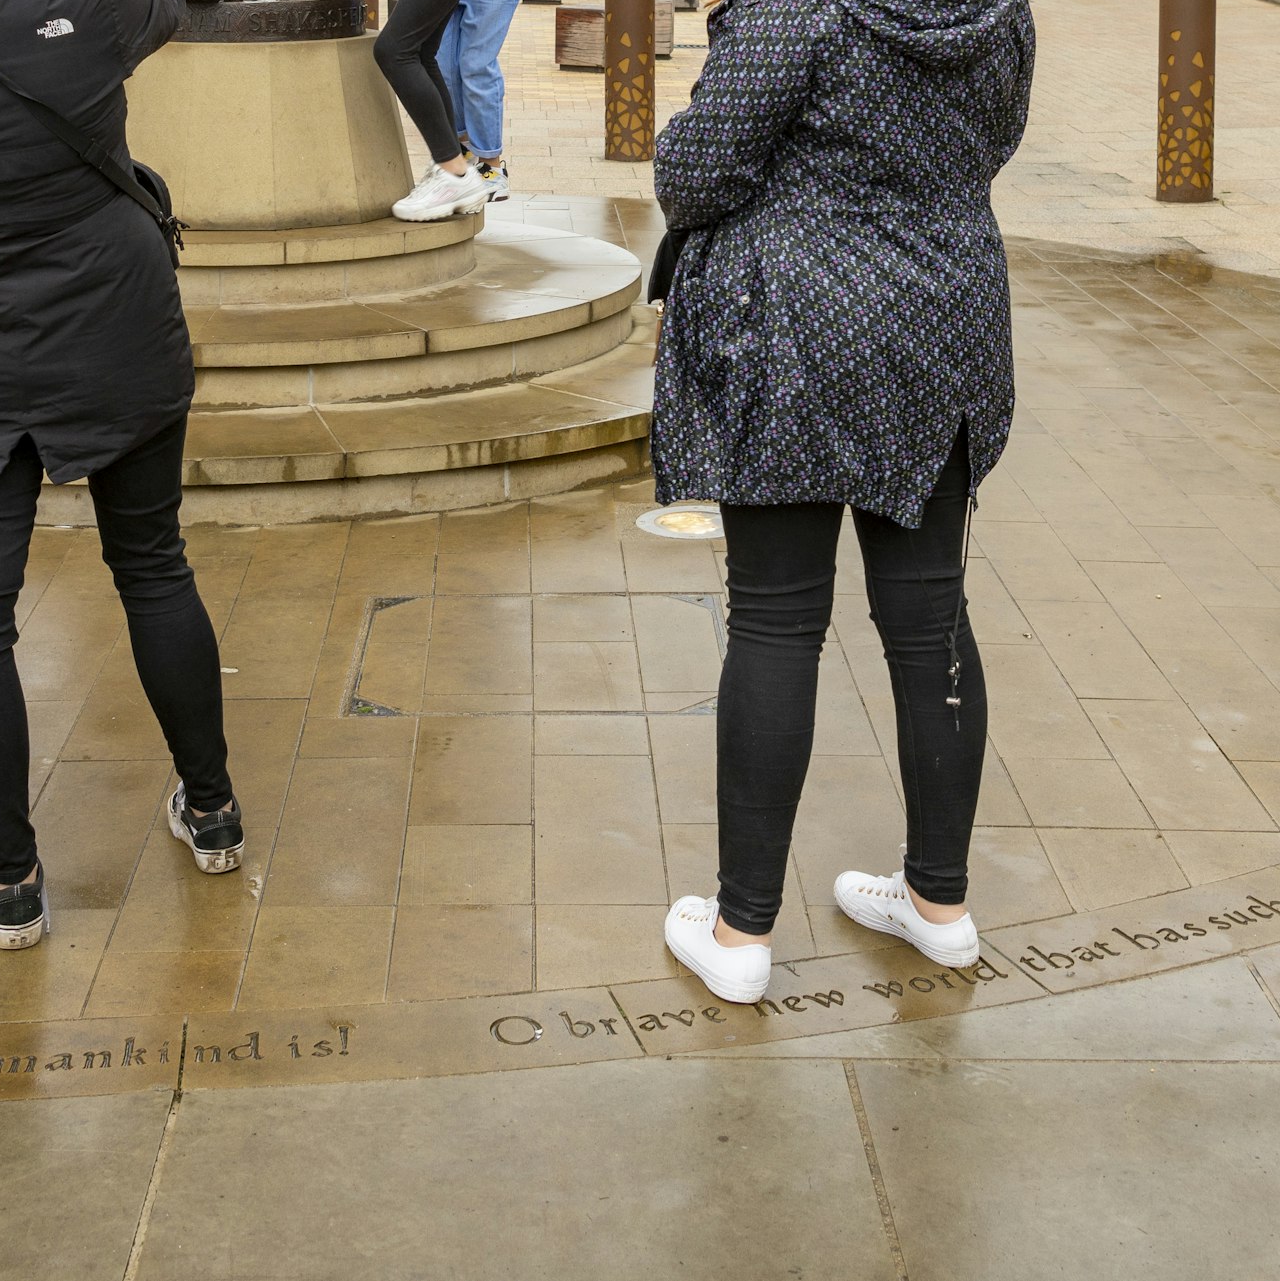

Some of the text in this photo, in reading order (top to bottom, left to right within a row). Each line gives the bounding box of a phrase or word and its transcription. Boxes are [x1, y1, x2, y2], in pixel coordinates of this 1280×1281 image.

[36, 26, 60, 36] NORTH
[489, 1015, 544, 1046] O
[558, 1005, 728, 1039] brave
[750, 988, 845, 1018] new
[862, 955, 1009, 999] world
[1019, 939, 1121, 972] that
[1112, 923, 1208, 950] has
[289, 1024, 352, 1060] is!
